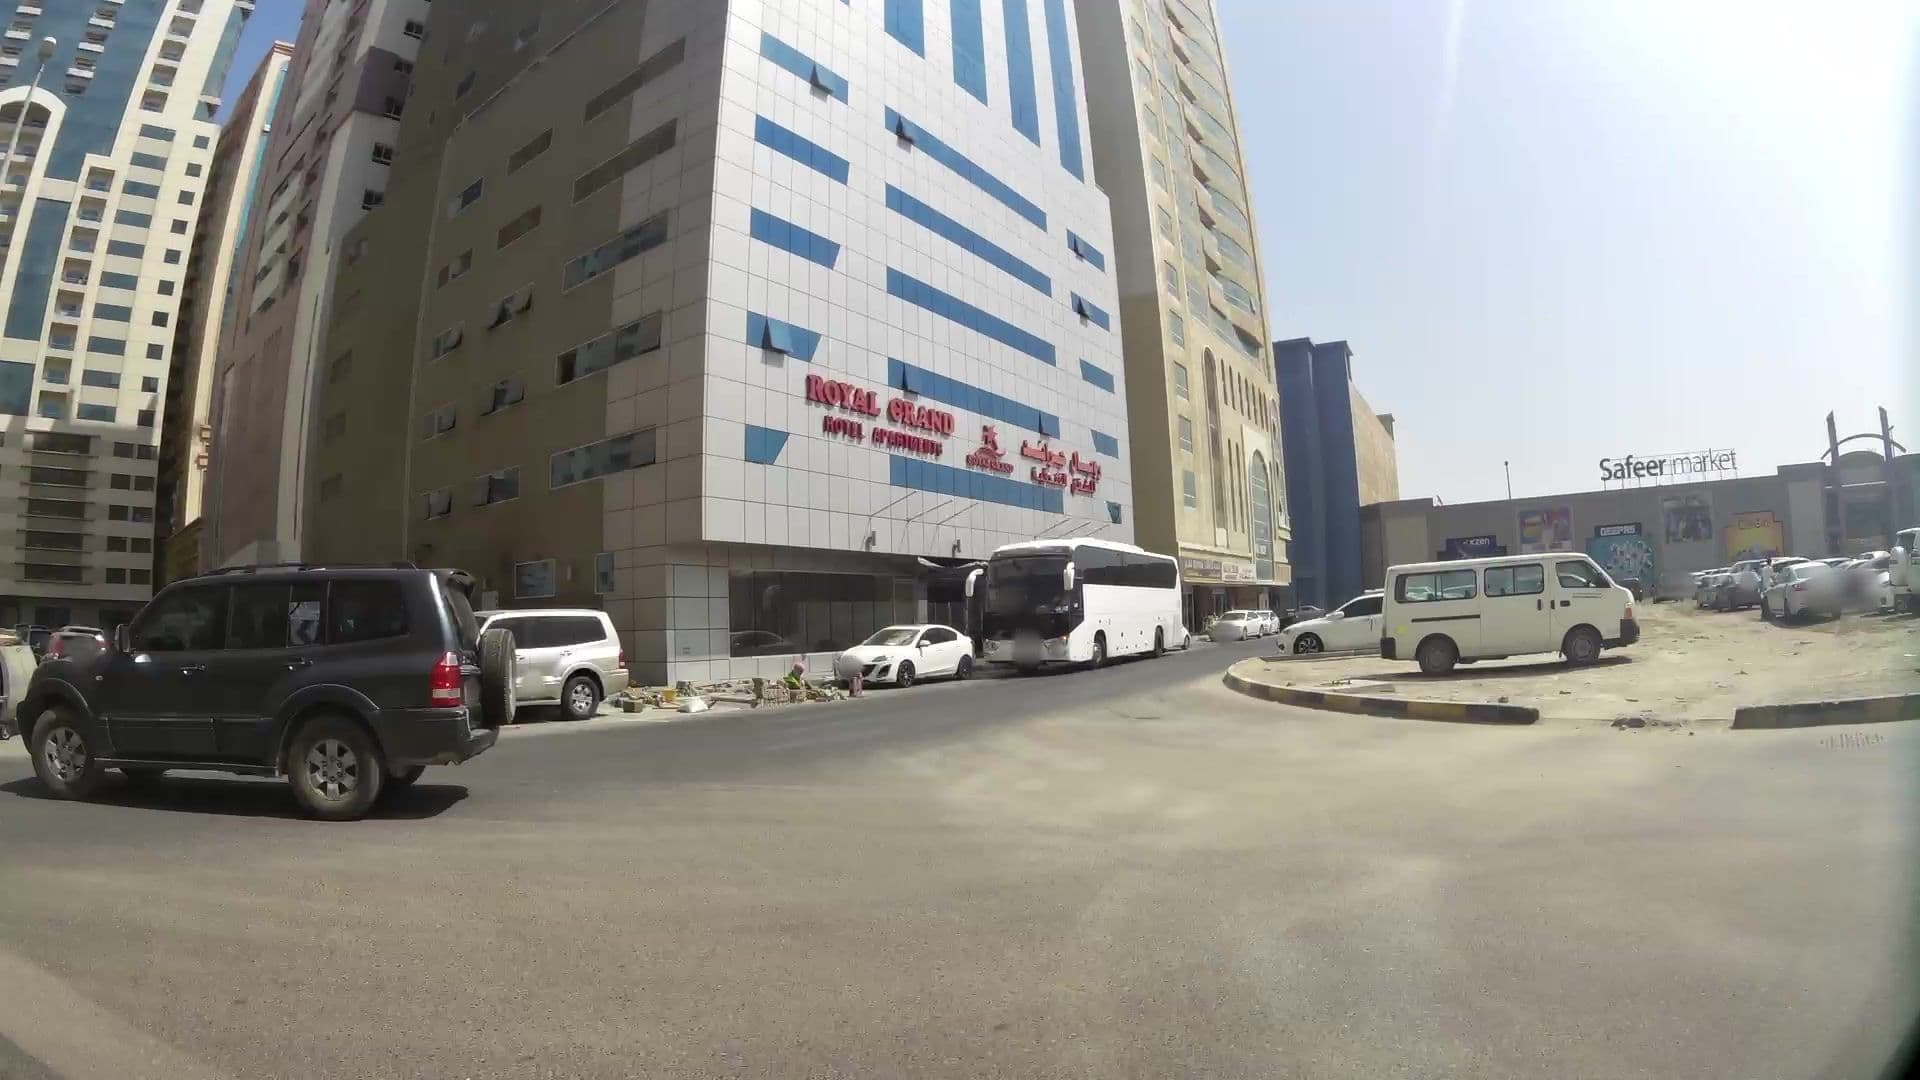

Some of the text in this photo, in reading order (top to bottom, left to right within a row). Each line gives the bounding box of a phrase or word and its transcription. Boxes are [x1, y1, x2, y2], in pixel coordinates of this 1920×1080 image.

[806, 374, 955, 436] ROYAL GRAND
[823, 415, 943, 456] HOTEL APARTMENTS
[1600, 448, 1736, 481] Safeer market
